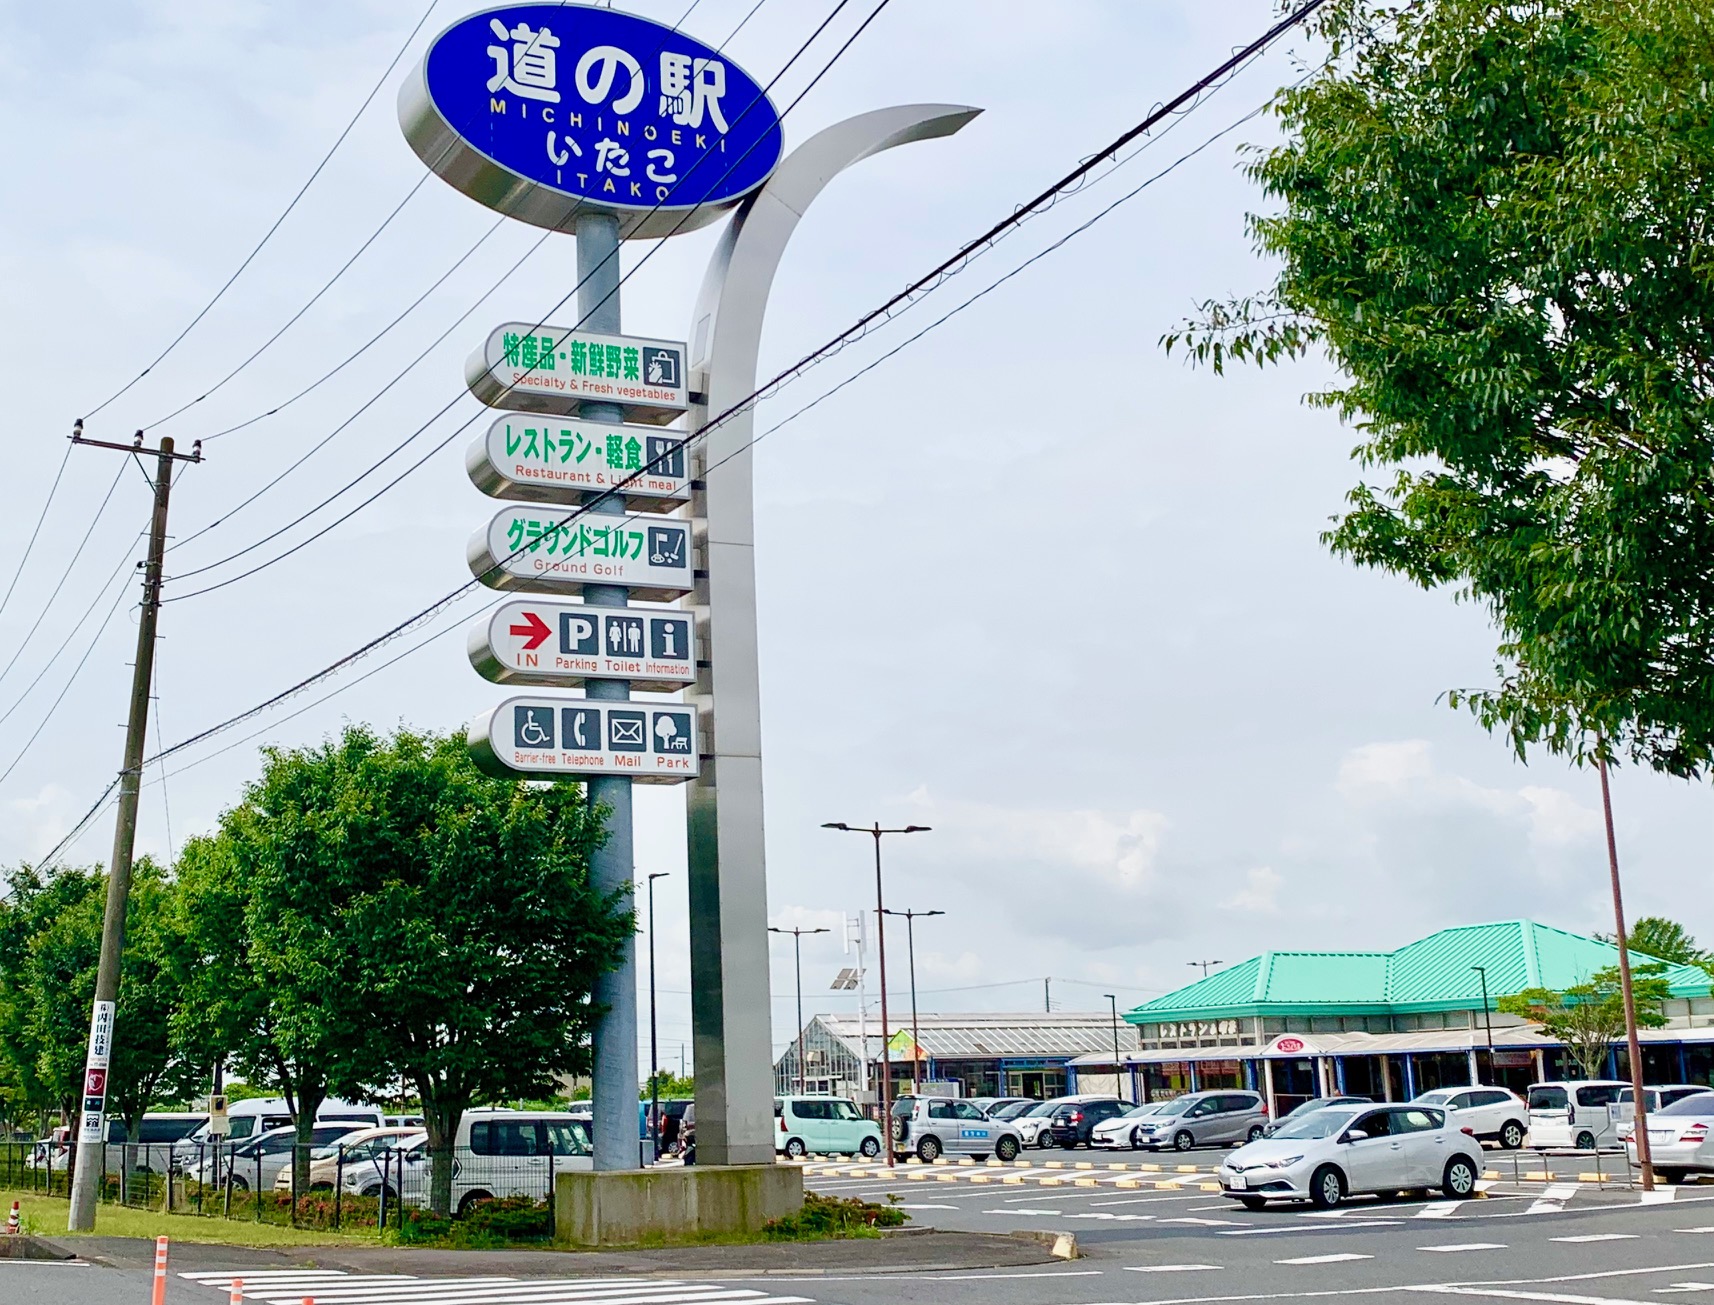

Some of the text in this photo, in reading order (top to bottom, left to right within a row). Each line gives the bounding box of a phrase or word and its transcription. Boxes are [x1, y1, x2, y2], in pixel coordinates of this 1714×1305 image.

[486, 18, 728, 134] 道の駅
[490, 99, 725, 152] MICHINOEKI
[546, 130, 677, 183] いたこ
[556, 170, 670, 200] ITAKO
[503, 332, 639, 381] 特産品・新鮮野菜
[513, 372, 676, 401] Specialty & Fresh vegetables
[506, 424, 642, 471] レストラン・軽食
[515, 465, 591, 483] Restaurant
[596, 473, 605, 484] &
[648, 480, 676, 491] meal
[507, 518, 644, 561] グラウンドゴルフ
[534, 559, 624, 577] Ground Golf
[568, 618, 593, 650] P
[516, 653, 539, 667] IN
[556, 657, 689, 675] Parking Toilet Information
[514, 752, 689, 768] Barrier-free Telephone Mail Park
